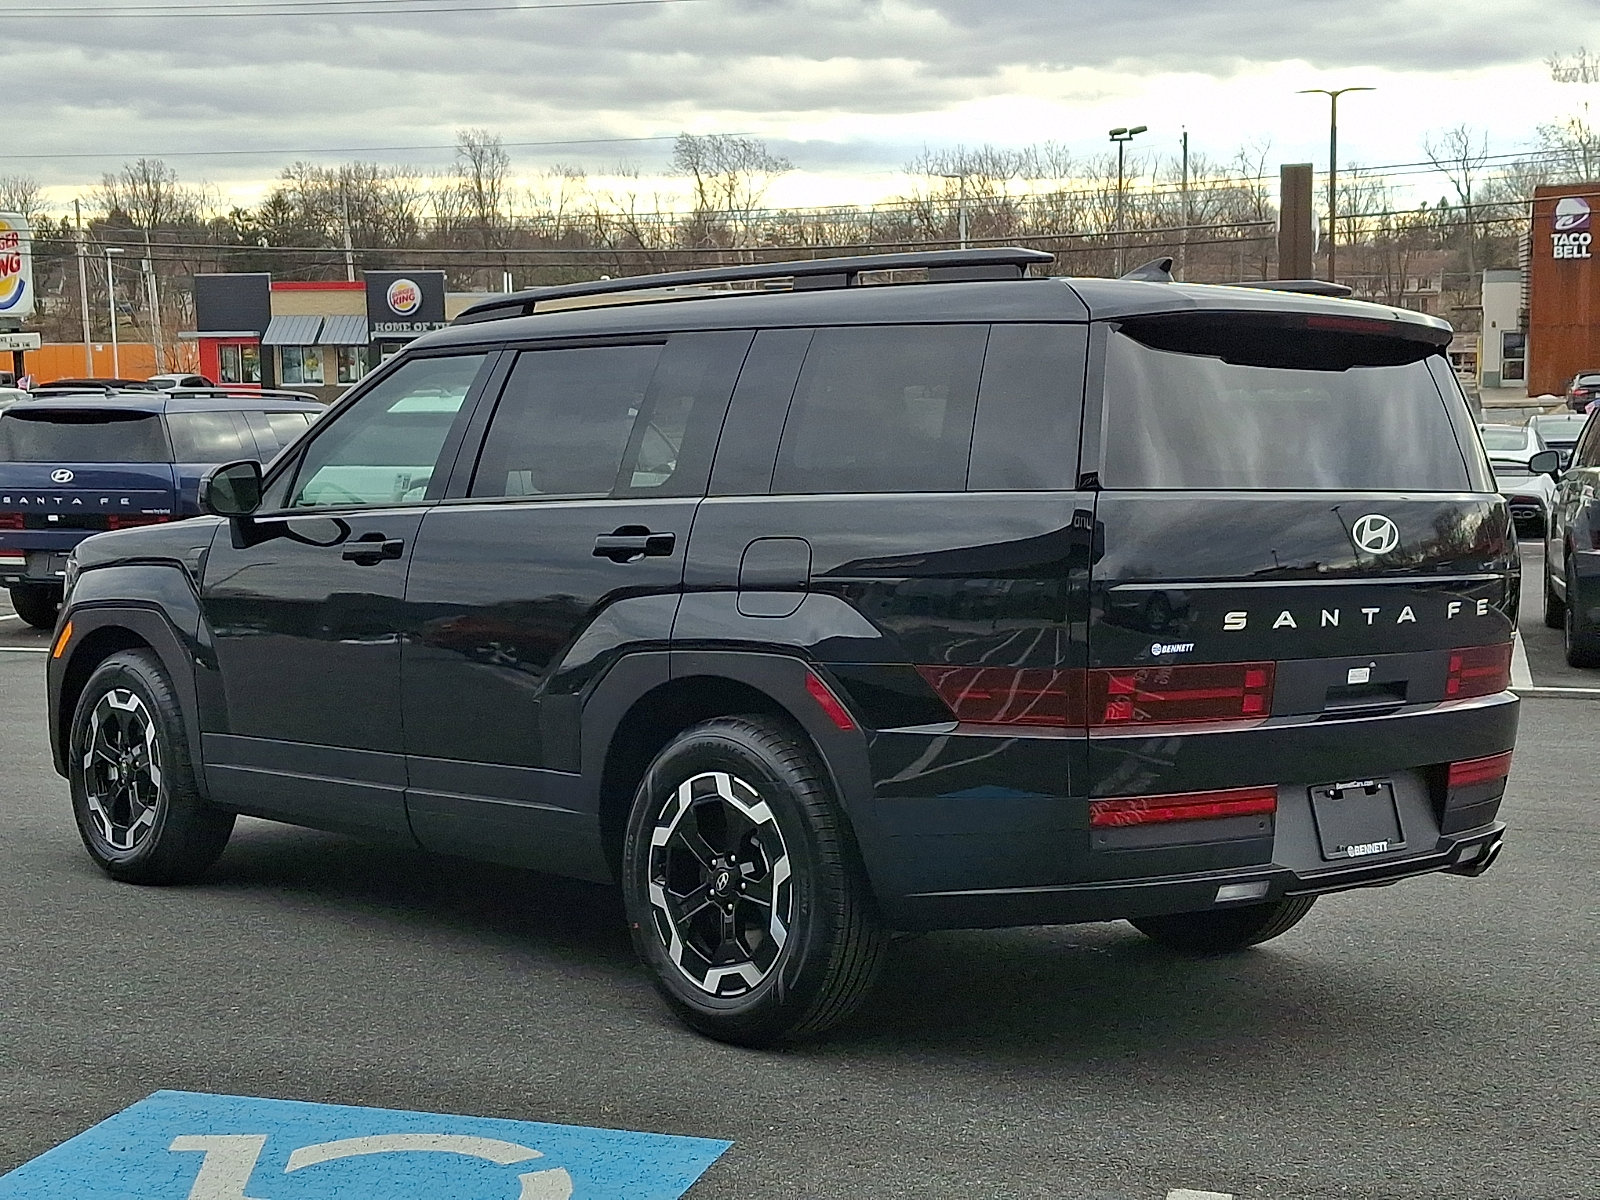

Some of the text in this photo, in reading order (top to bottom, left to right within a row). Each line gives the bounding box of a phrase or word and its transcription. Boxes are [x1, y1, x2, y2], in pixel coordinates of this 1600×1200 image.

[1550, 232, 1592, 246] TACO
[1553, 245, 1592, 258] BELL
[394, 294, 415, 305] KING
[375, 322, 411, 332] HOME
[413, 322, 430, 332] OF
[3, 496, 130, 505] SANTA FE
[1223, 599, 1489, 631] SANTA FE
[1161, 643, 1194, 654] BENNETT
[1354, 841, 1388, 856] BENNETT
